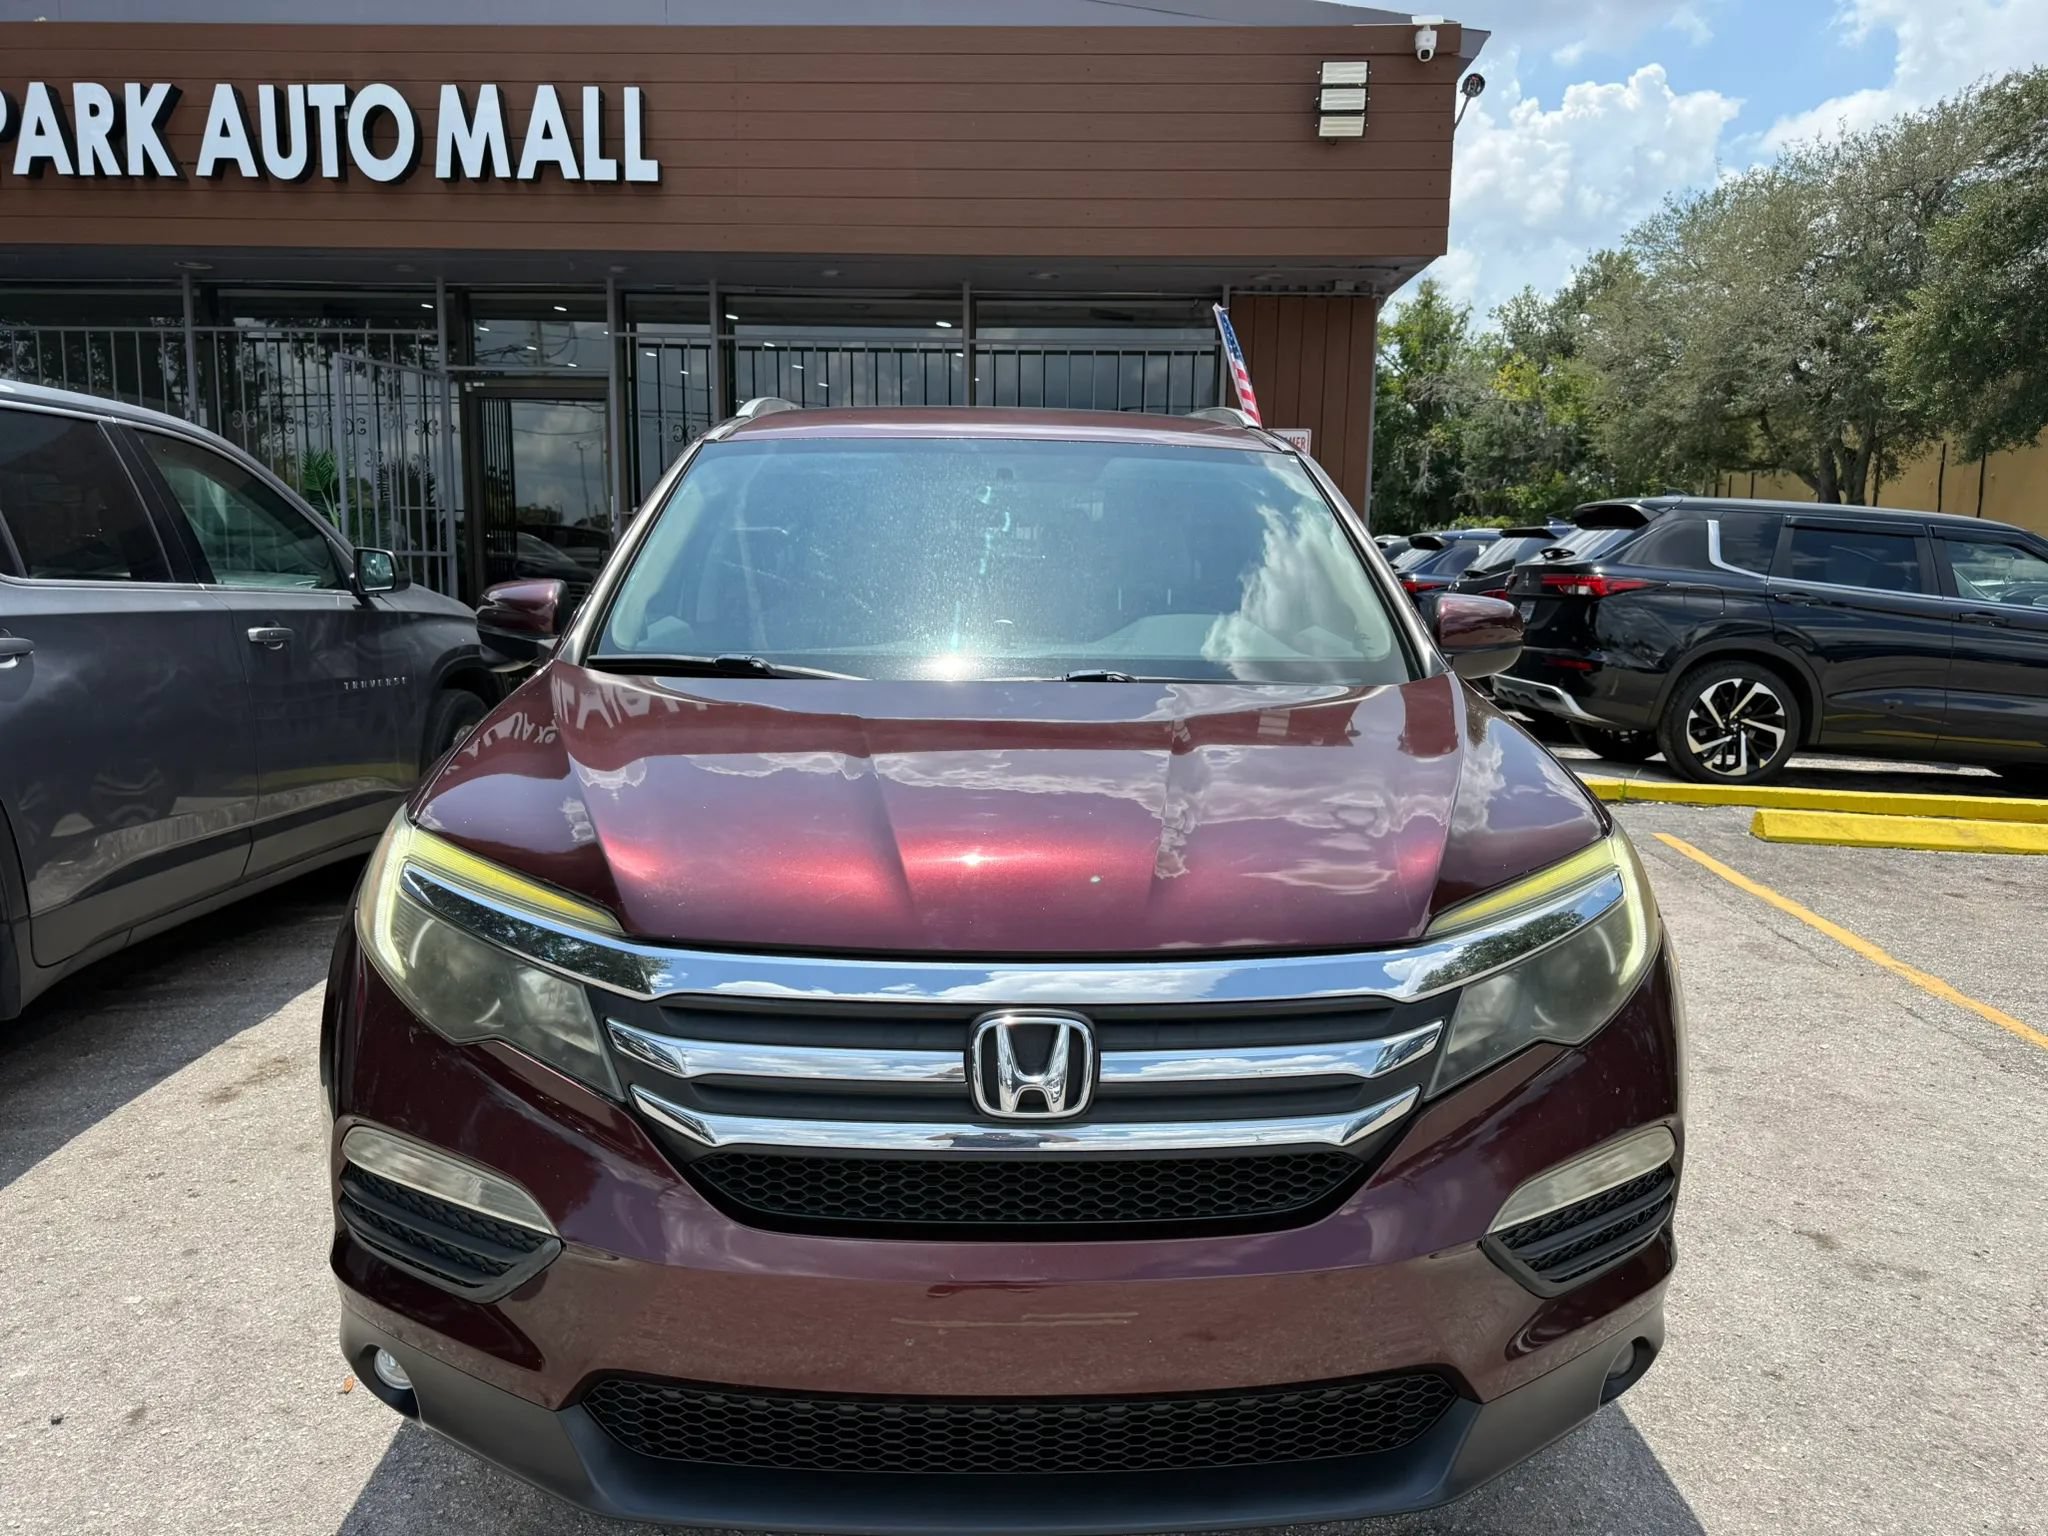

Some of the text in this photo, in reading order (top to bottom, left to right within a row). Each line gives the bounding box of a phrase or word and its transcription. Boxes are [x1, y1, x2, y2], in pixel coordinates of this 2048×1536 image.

[0, 82, 660, 182] ARK AUTO MALL
